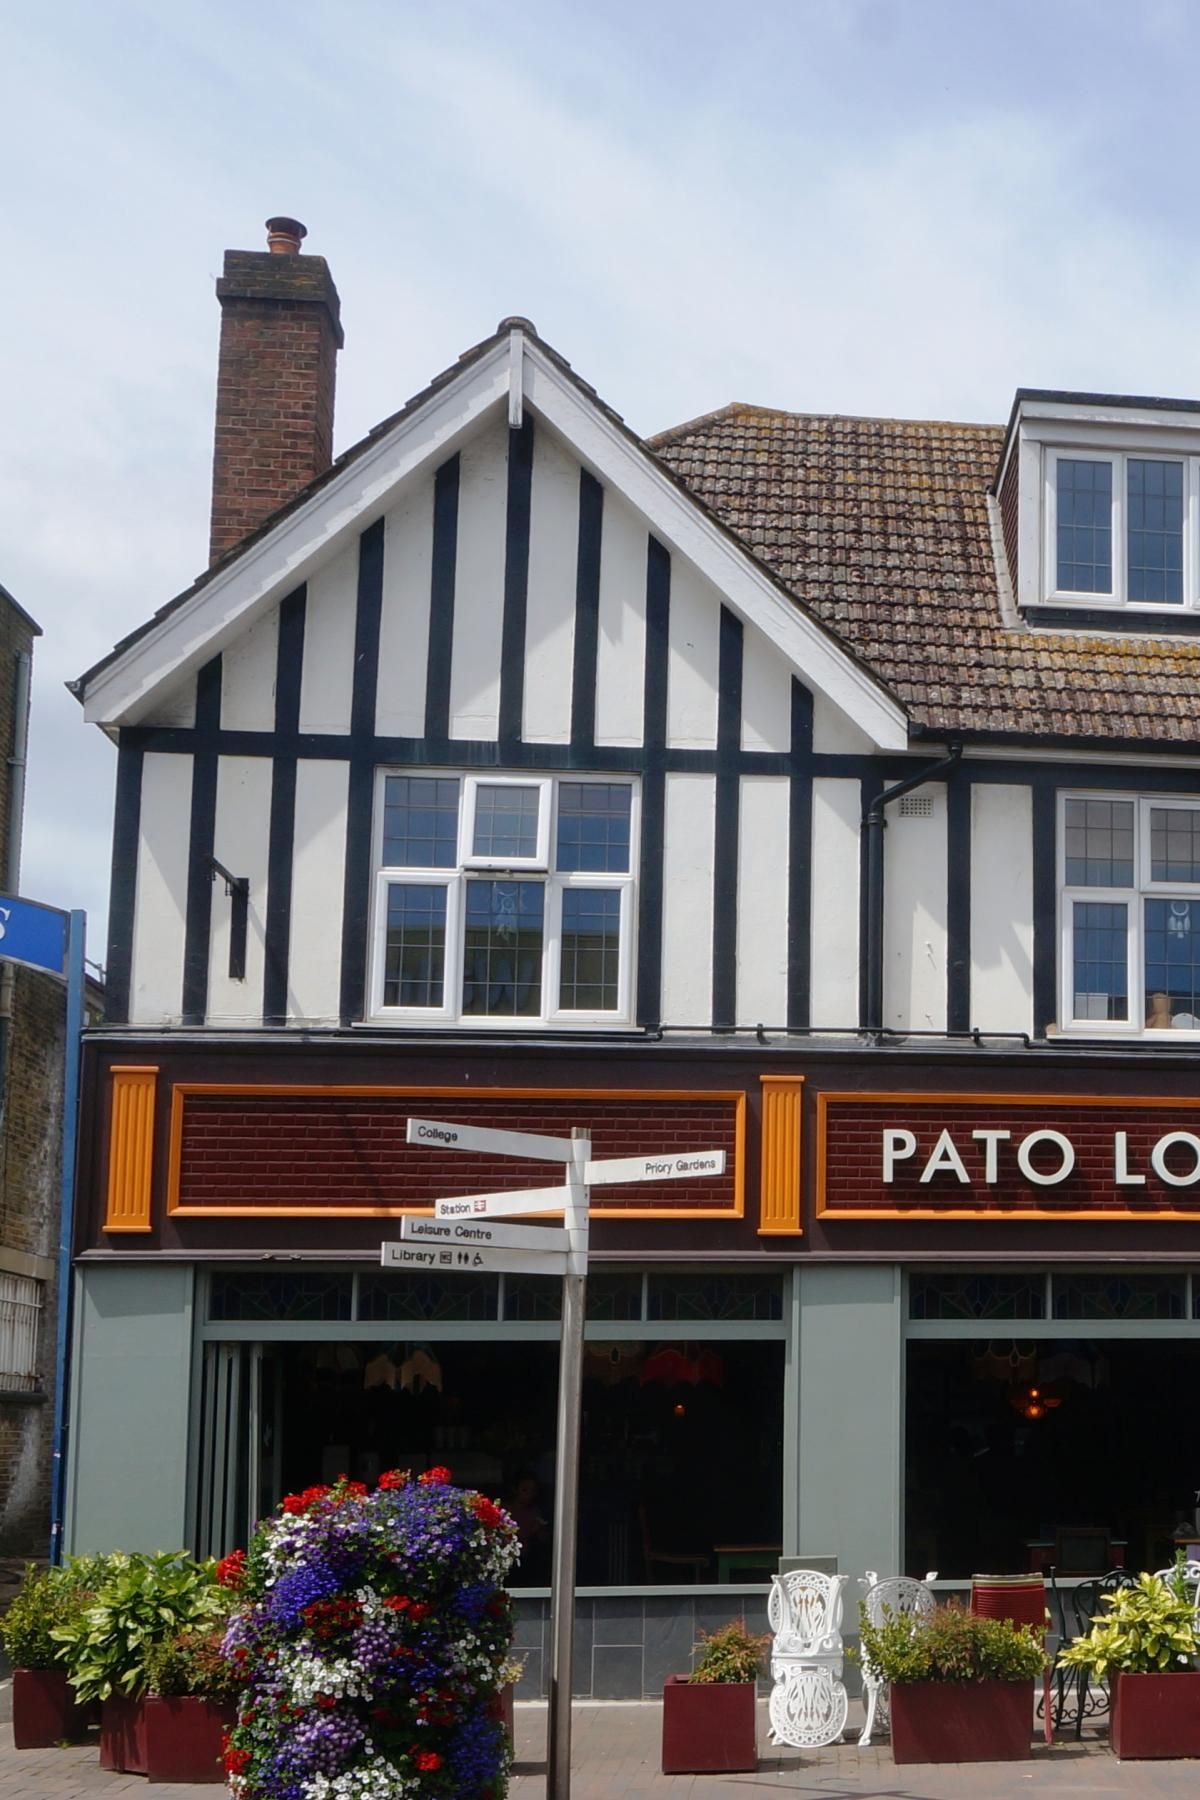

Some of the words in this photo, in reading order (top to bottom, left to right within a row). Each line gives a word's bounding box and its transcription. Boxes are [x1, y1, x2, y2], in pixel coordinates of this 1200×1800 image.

[417, 1126, 458, 1143] College
[882, 1128, 1075, 1185] PATO
[645, 1162, 673, 1175] Priory
[675, 1159, 716, 1172] Gardens
[440, 1203, 471, 1215] Station
[411, 1222, 451, 1237] Leisure
[455, 1226, 492, 1240] Centre
[391, 1249, 436, 1265] Library
